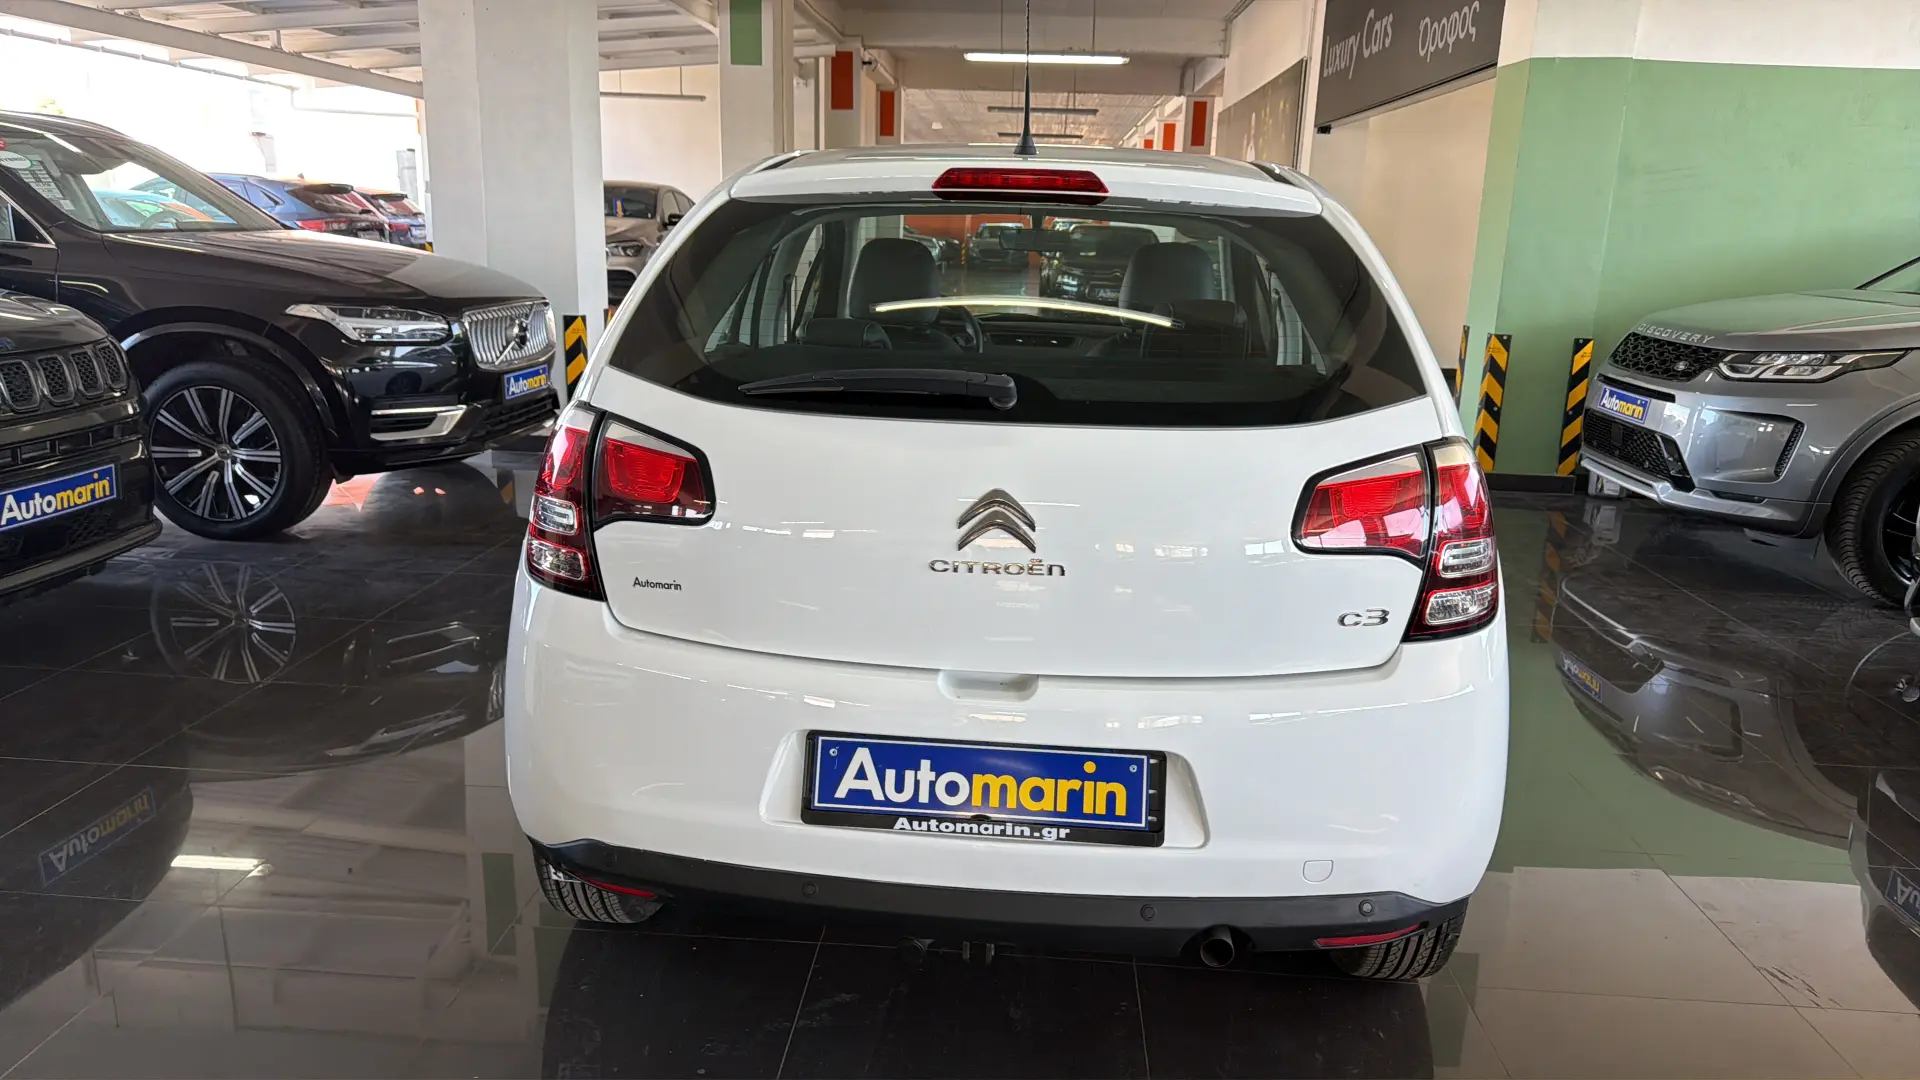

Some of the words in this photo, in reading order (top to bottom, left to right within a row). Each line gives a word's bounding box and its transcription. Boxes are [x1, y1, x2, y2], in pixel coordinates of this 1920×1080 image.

[1323, 31, 1361, 80] Luxury
[1362, 8, 1394, 58] Cars
[1638, 323, 1715, 344] DISCOVERY
[509, 368, 547, 396] Automarin
[1600, 390, 1645, 419] Automarin
[0, 472, 110, 526] Automarin
[632, 576, 682, 591] Automarin
[1337, 608, 1390, 627] C3
[834, 747, 1127, 816] Automarin
[893, 817, 1071, 841] Automarin.gr
